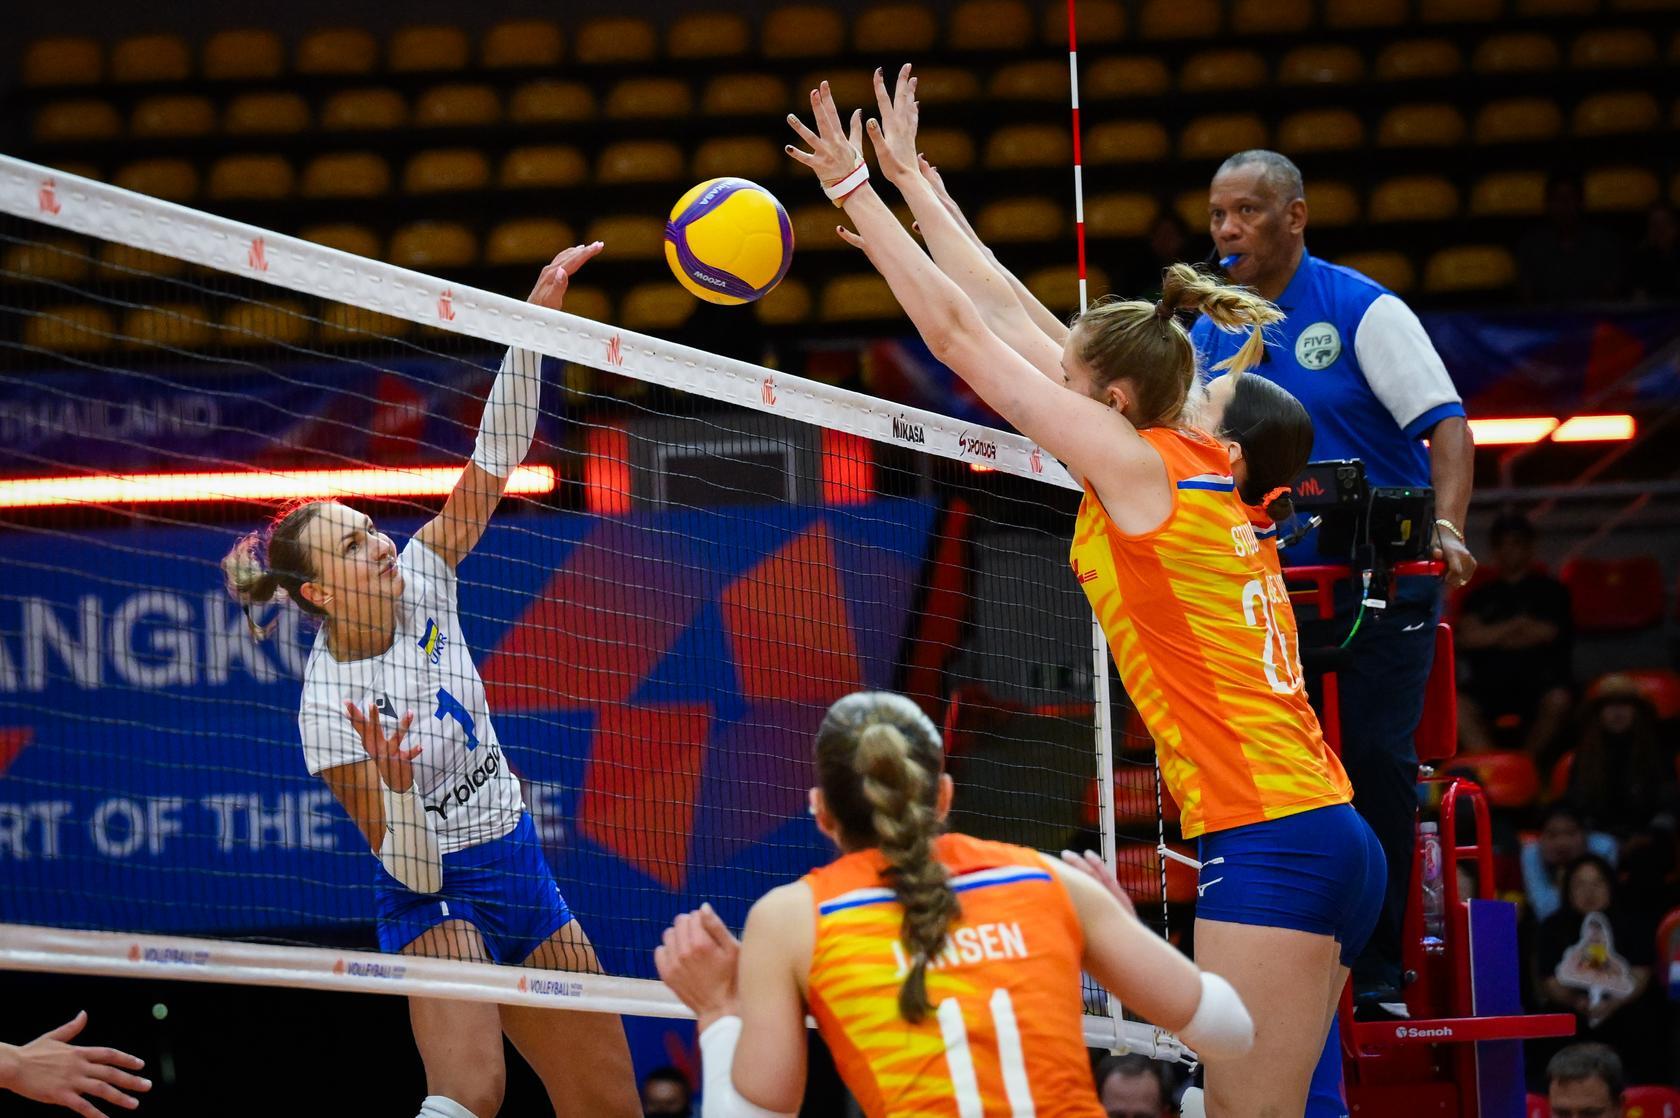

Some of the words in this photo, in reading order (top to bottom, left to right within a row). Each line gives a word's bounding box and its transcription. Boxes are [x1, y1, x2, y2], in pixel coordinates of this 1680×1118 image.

[694, 271, 726, 288] V200W
[1303, 334, 1332, 348] FIVB
[1296, 478, 1326, 497] VNL
[430, 632, 448, 665] UKR
[92, 797, 184, 857] OF
[201, 789, 338, 853] THE
[530, 979, 570, 997] VOLLEYBALL
[1408, 1026, 1453, 1038] Senoh
